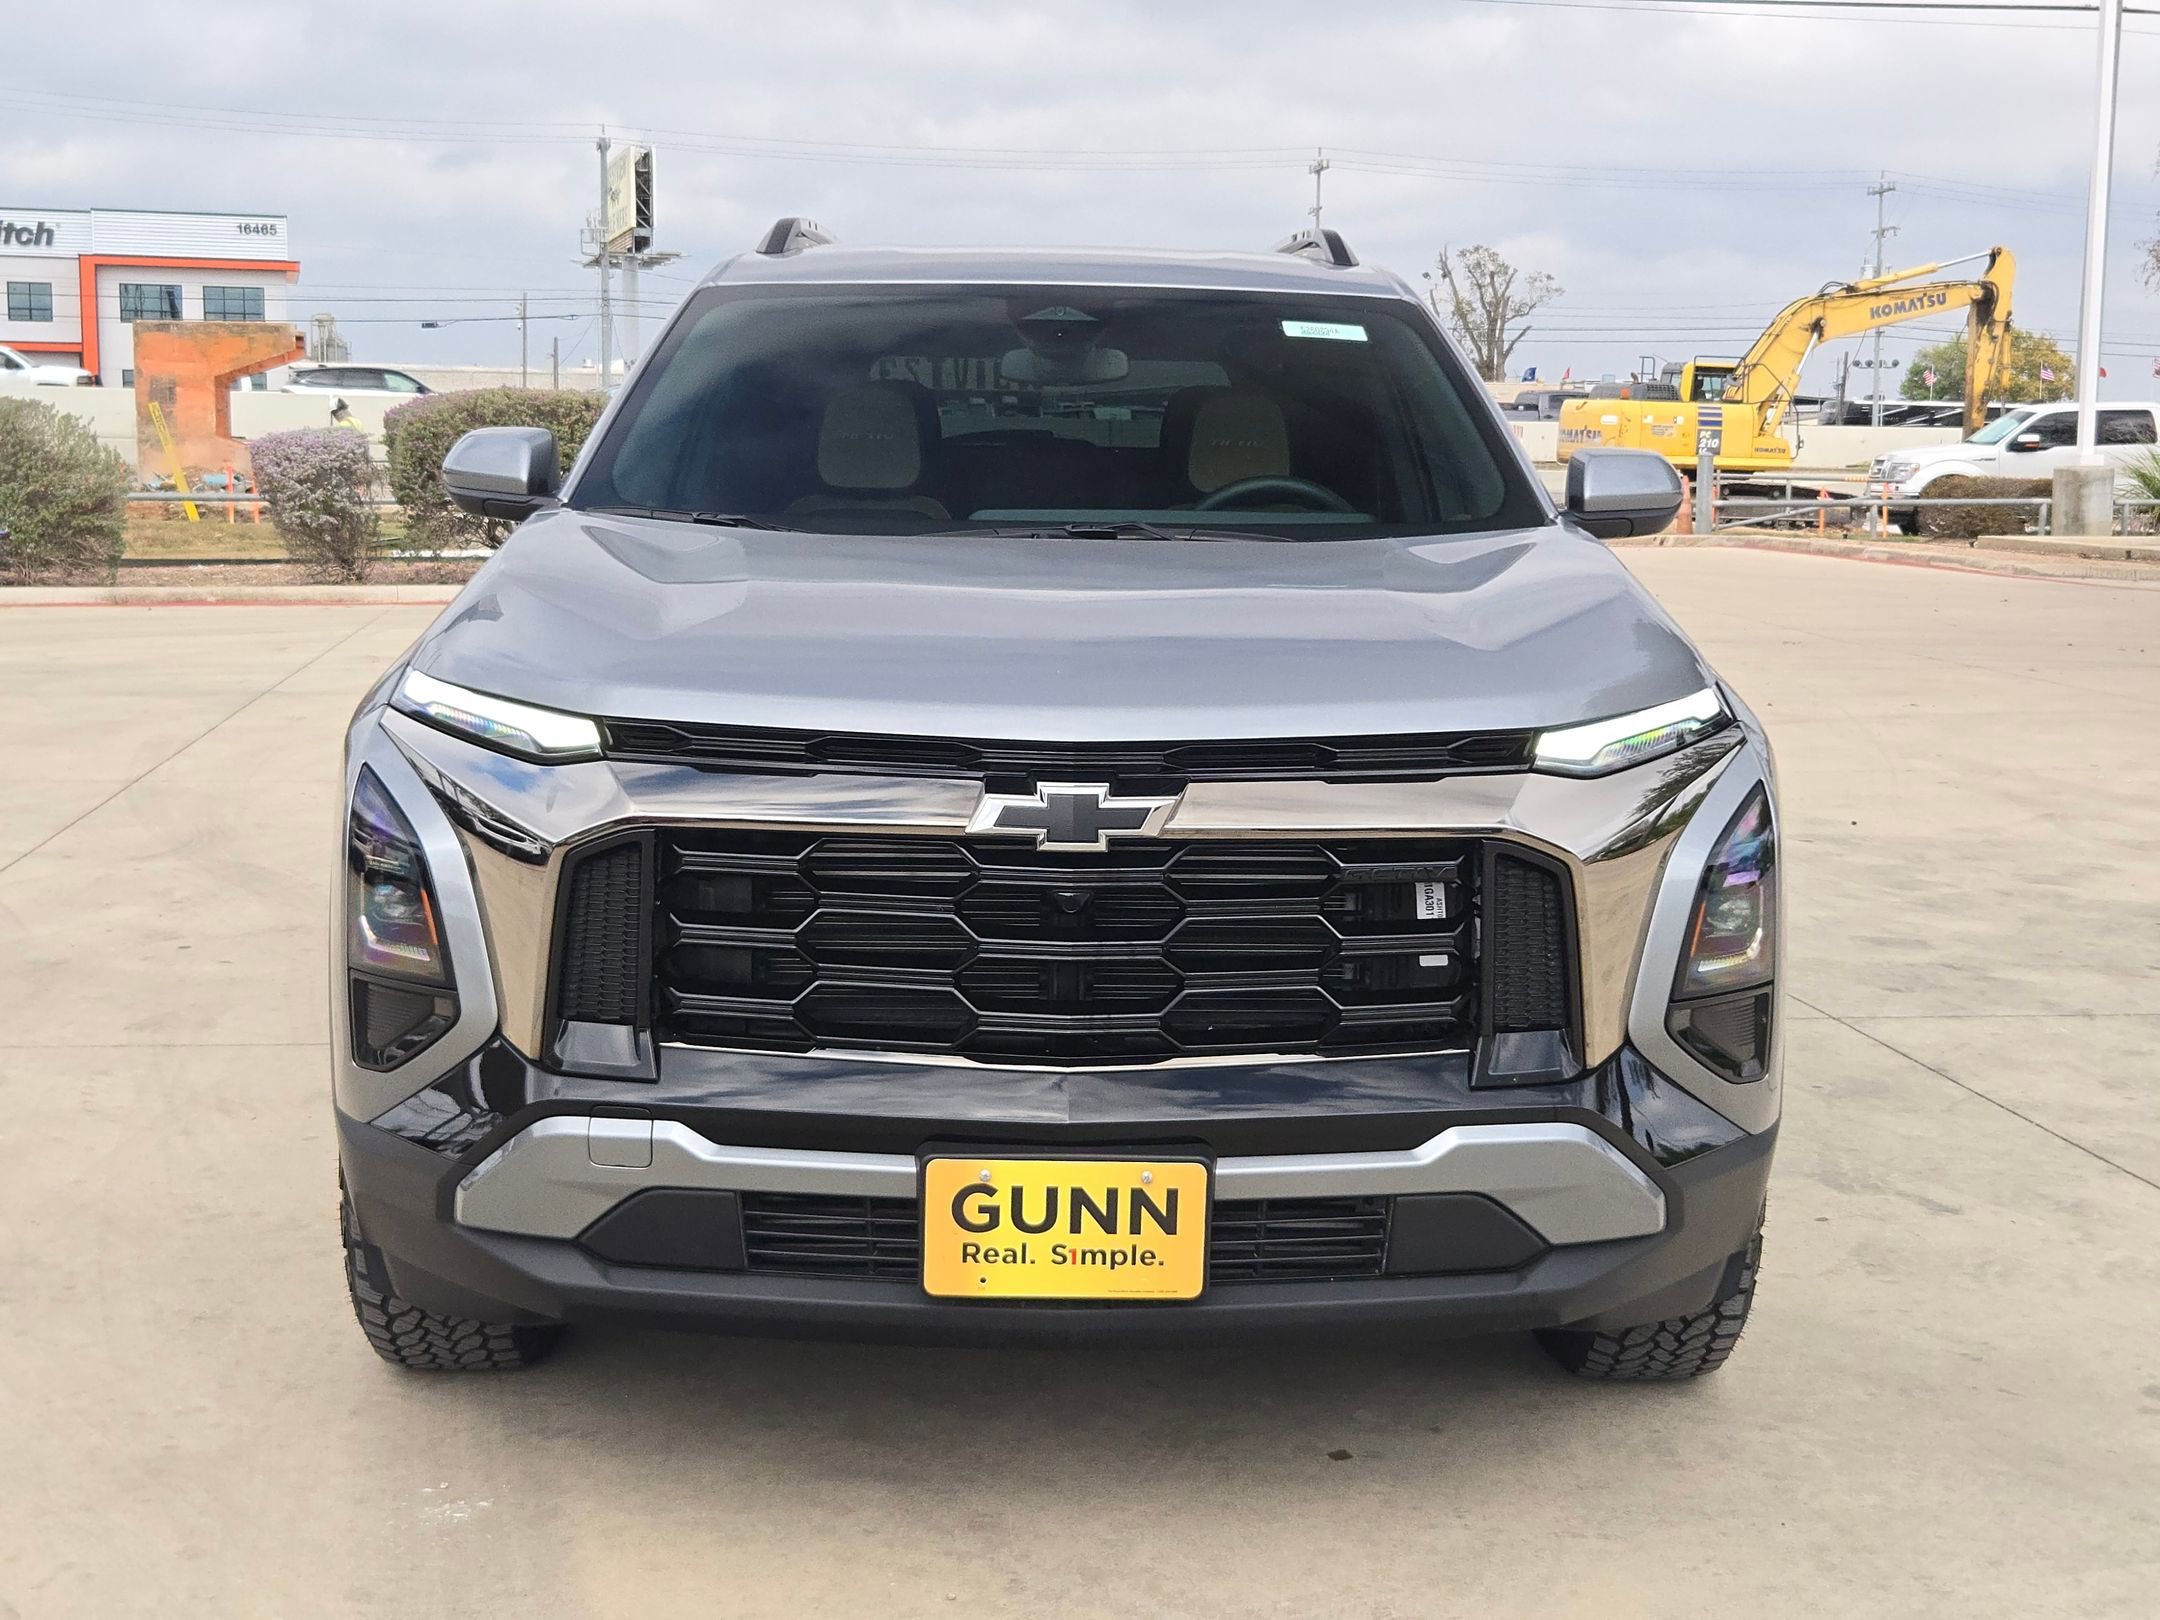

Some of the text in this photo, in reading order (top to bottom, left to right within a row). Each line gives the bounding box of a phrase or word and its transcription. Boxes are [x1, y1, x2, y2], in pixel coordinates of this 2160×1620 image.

[237, 223, 277, 235] 16465
[1869, 292, 1947, 320] KOMATSU
[1698, 438, 1719, 448] 210
[951, 1182, 1179, 1236] GUNN
[961, 1242, 1036, 1265] Real.
